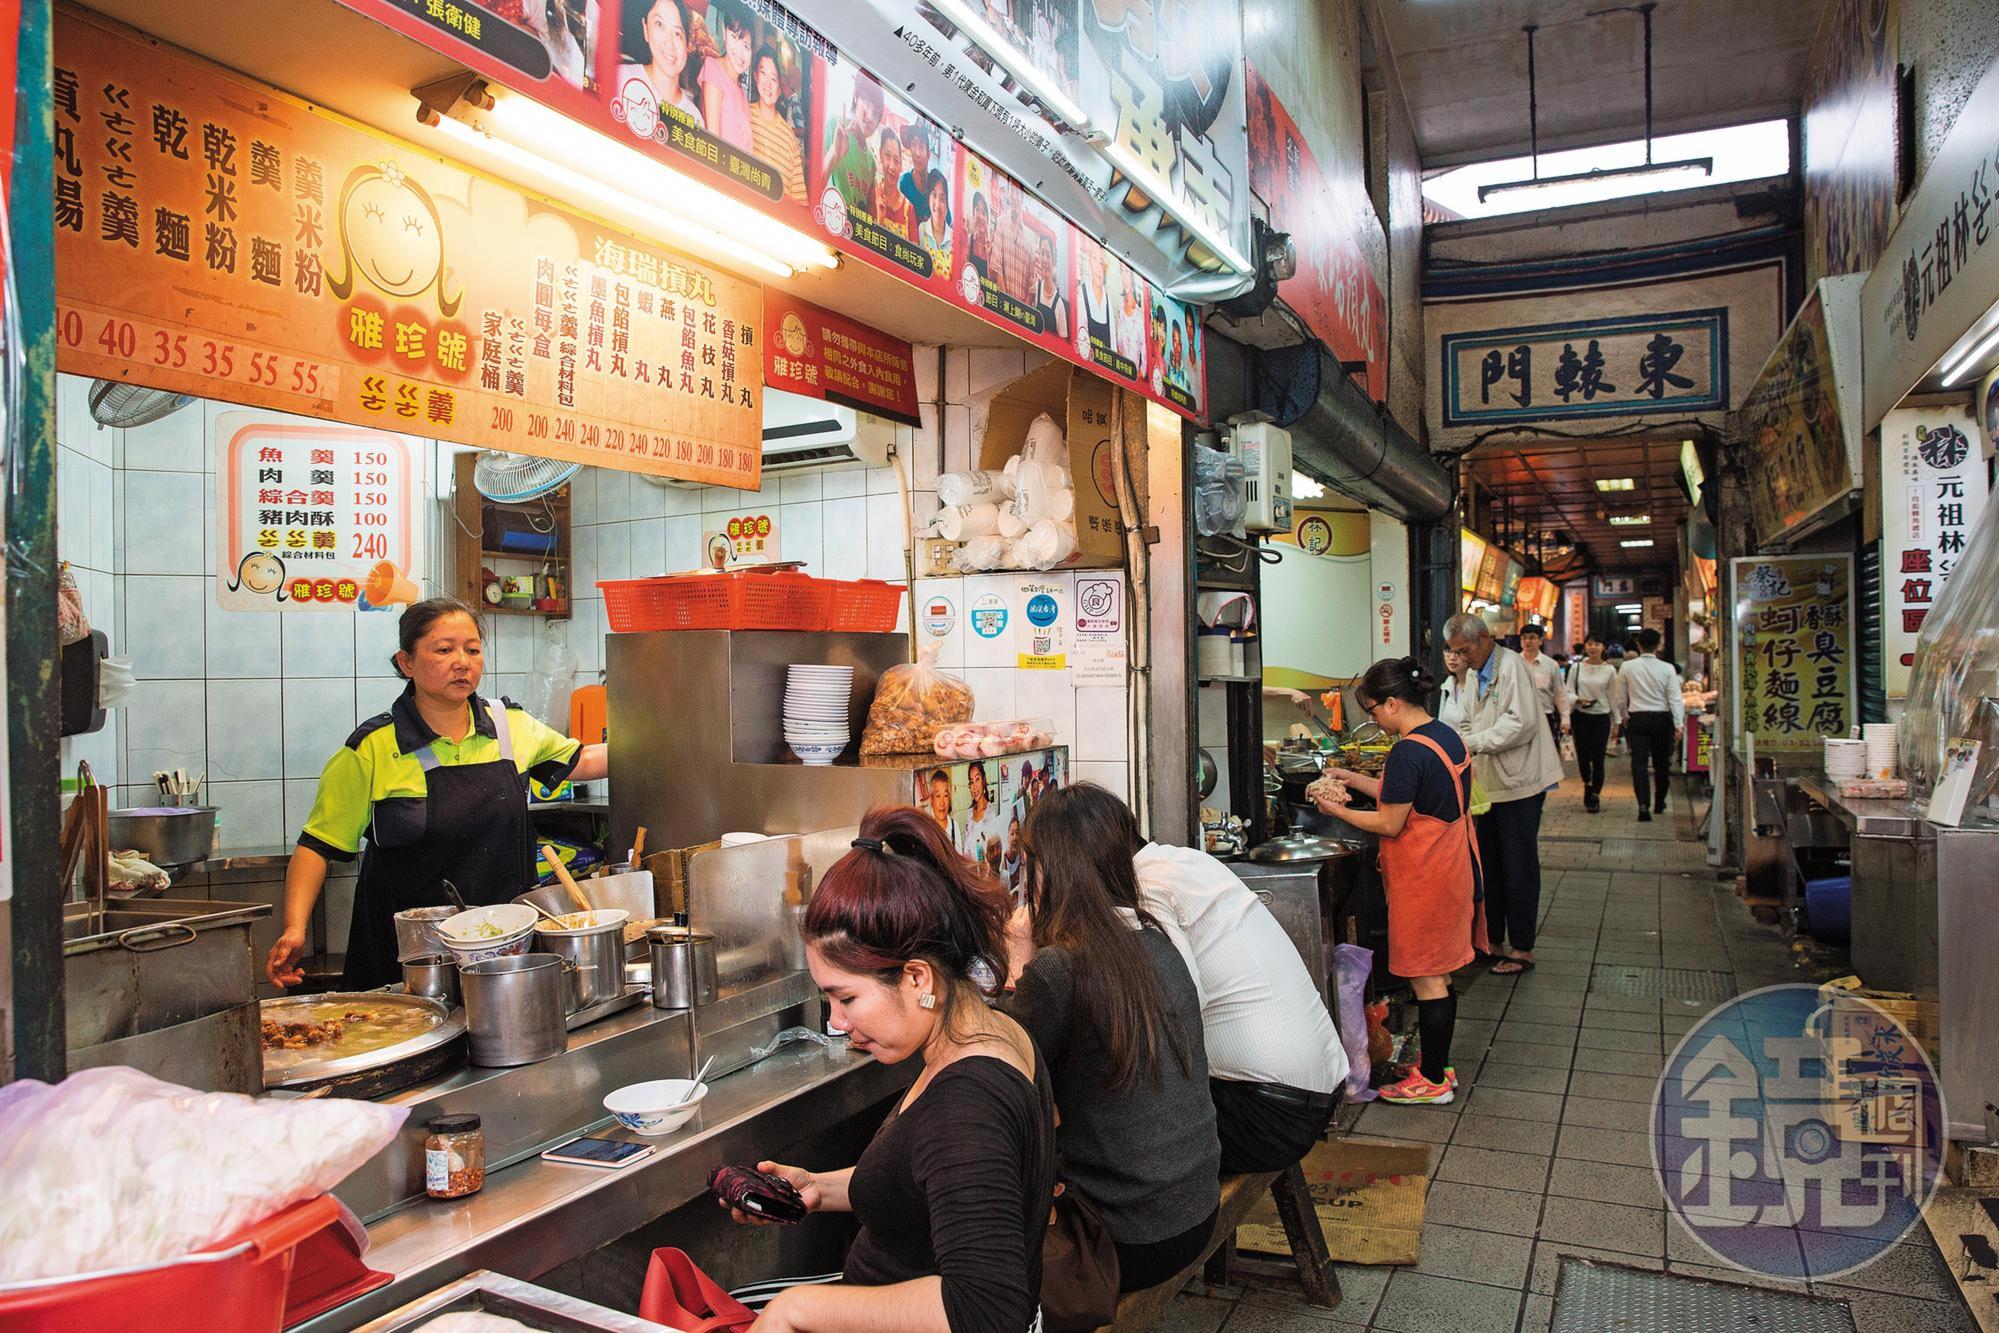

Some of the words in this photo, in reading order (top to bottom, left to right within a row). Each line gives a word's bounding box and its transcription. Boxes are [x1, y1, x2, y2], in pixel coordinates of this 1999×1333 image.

[203, 122, 238, 274] 乾米粉
[294, 156, 324, 297] 羹米粉
[350, 306, 467, 373] 雅珍號
[532, 257, 556, 360] 肉圓每盒
[586, 275, 608, 373] 墨魚摃丸
[610, 282, 630, 378] 包餡摃丸
[55, 308, 83, 348] 0
[98, 318, 136, 359] 40
[153, 330, 187, 369] 35
[202, 341, 234, 378] 35
[249, 352, 278, 386] 55
[291, 361, 319, 396] 55
[481, 311, 503, 391] 家庭桶
[679, 305, 697, 395] 包餡魚丸
[720, 319, 736, 404] 香菇摃丸
[773, 355, 819, 386] 雅珍號
[353, 452, 388, 466] 150
[491, 405, 513, 433] 200
[527, 414, 548, 439] 200
[555, 416, 575, 441] 240
[580, 422, 600, 447] 240
[605, 428, 624, 451] 220
[629, 432, 648, 454] 240
[653, 437, 671, 460] 220
[675, 438, 692, 462] 180
[697, 443, 714, 466] 200
[718, 446, 734, 469] 180
[738, 449, 753, 472] 180
[258, 489, 335, 506] 綜合羹
[353, 492, 388, 506] 150
[353, 472, 388, 486] 150
[258, 510, 335, 526] 豬肉酥
[353, 512, 388, 527] 100
[352, 532, 387, 560] 240
[728, 516, 770, 537] 雅珍號
[1308, 519, 1323, 552] 林記
[281, 551, 336, 560] 綜合材料包
[292, 581, 358, 600] 雅珍號
[1900, 548, 1933, 633] 座位區
[1760, 606, 1804, 734] 蚵仔麵線
[1807, 631, 1845, 734] 臭豆腐
